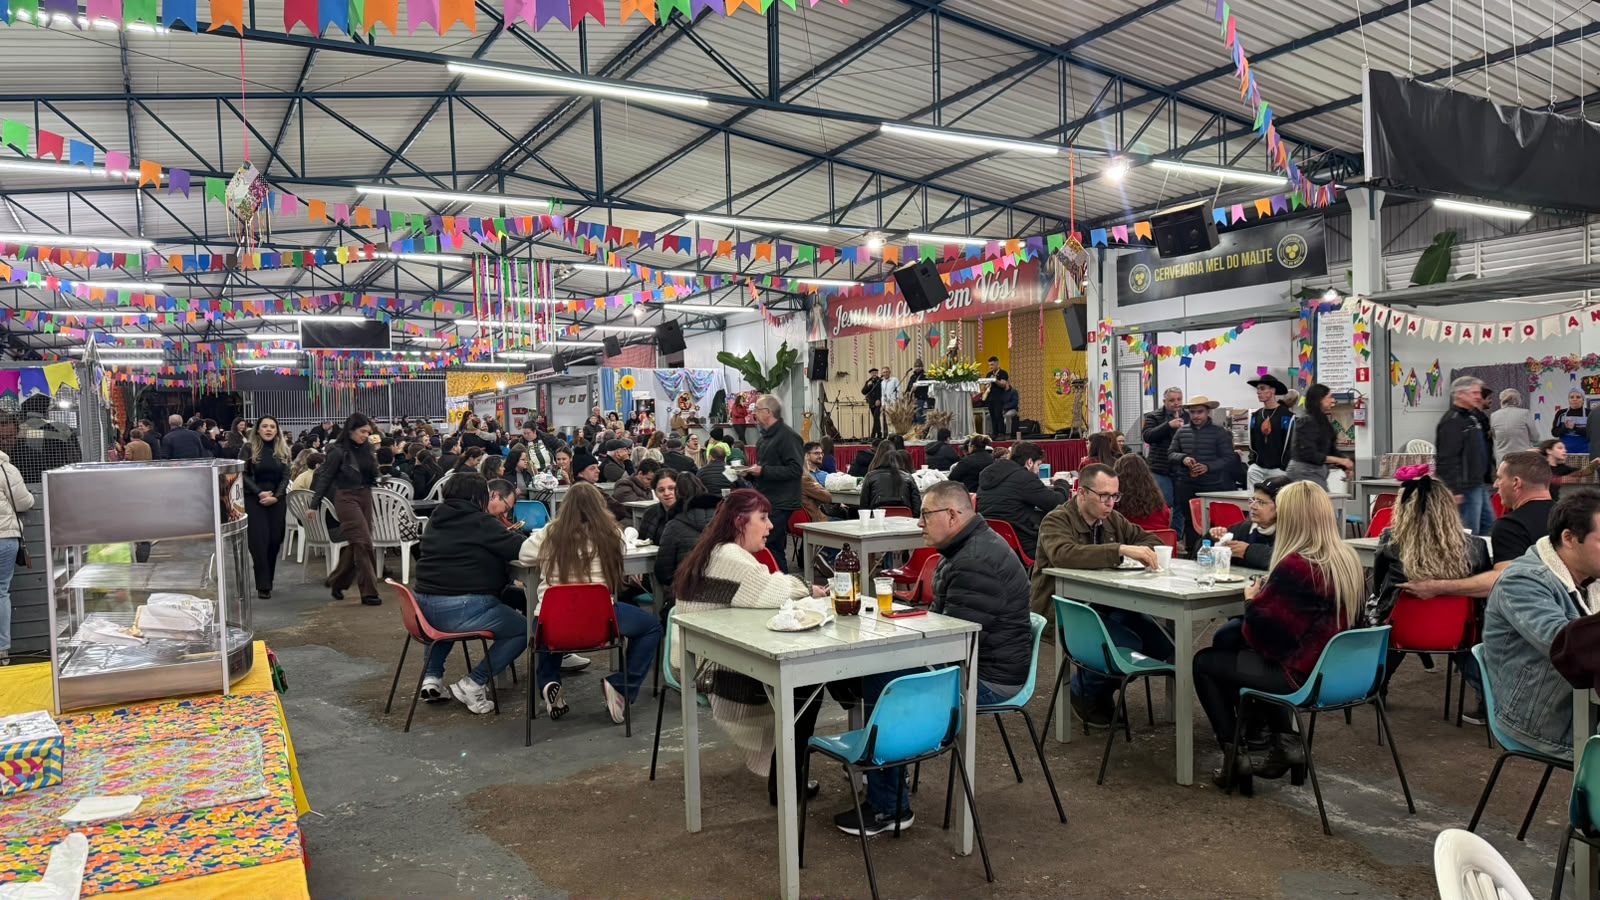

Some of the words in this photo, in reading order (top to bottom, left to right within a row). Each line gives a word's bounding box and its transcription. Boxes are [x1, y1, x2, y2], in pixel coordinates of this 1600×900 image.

[1154, 261, 1204, 282] CERVEJARIA
[1205, 257, 1225, 273] MEL
[1226, 254, 1239, 270] DO
[1241, 248, 1273, 267] MALTE
[875, 303, 894, 323] eu
[945, 286, 972, 310] em
[975, 269, 1019, 304] Vós!
[1361, 305, 1416, 332] VIVA
[1444, 325, 1535, 339] SANTO
[1101, 345, 1109, 381] BAR
